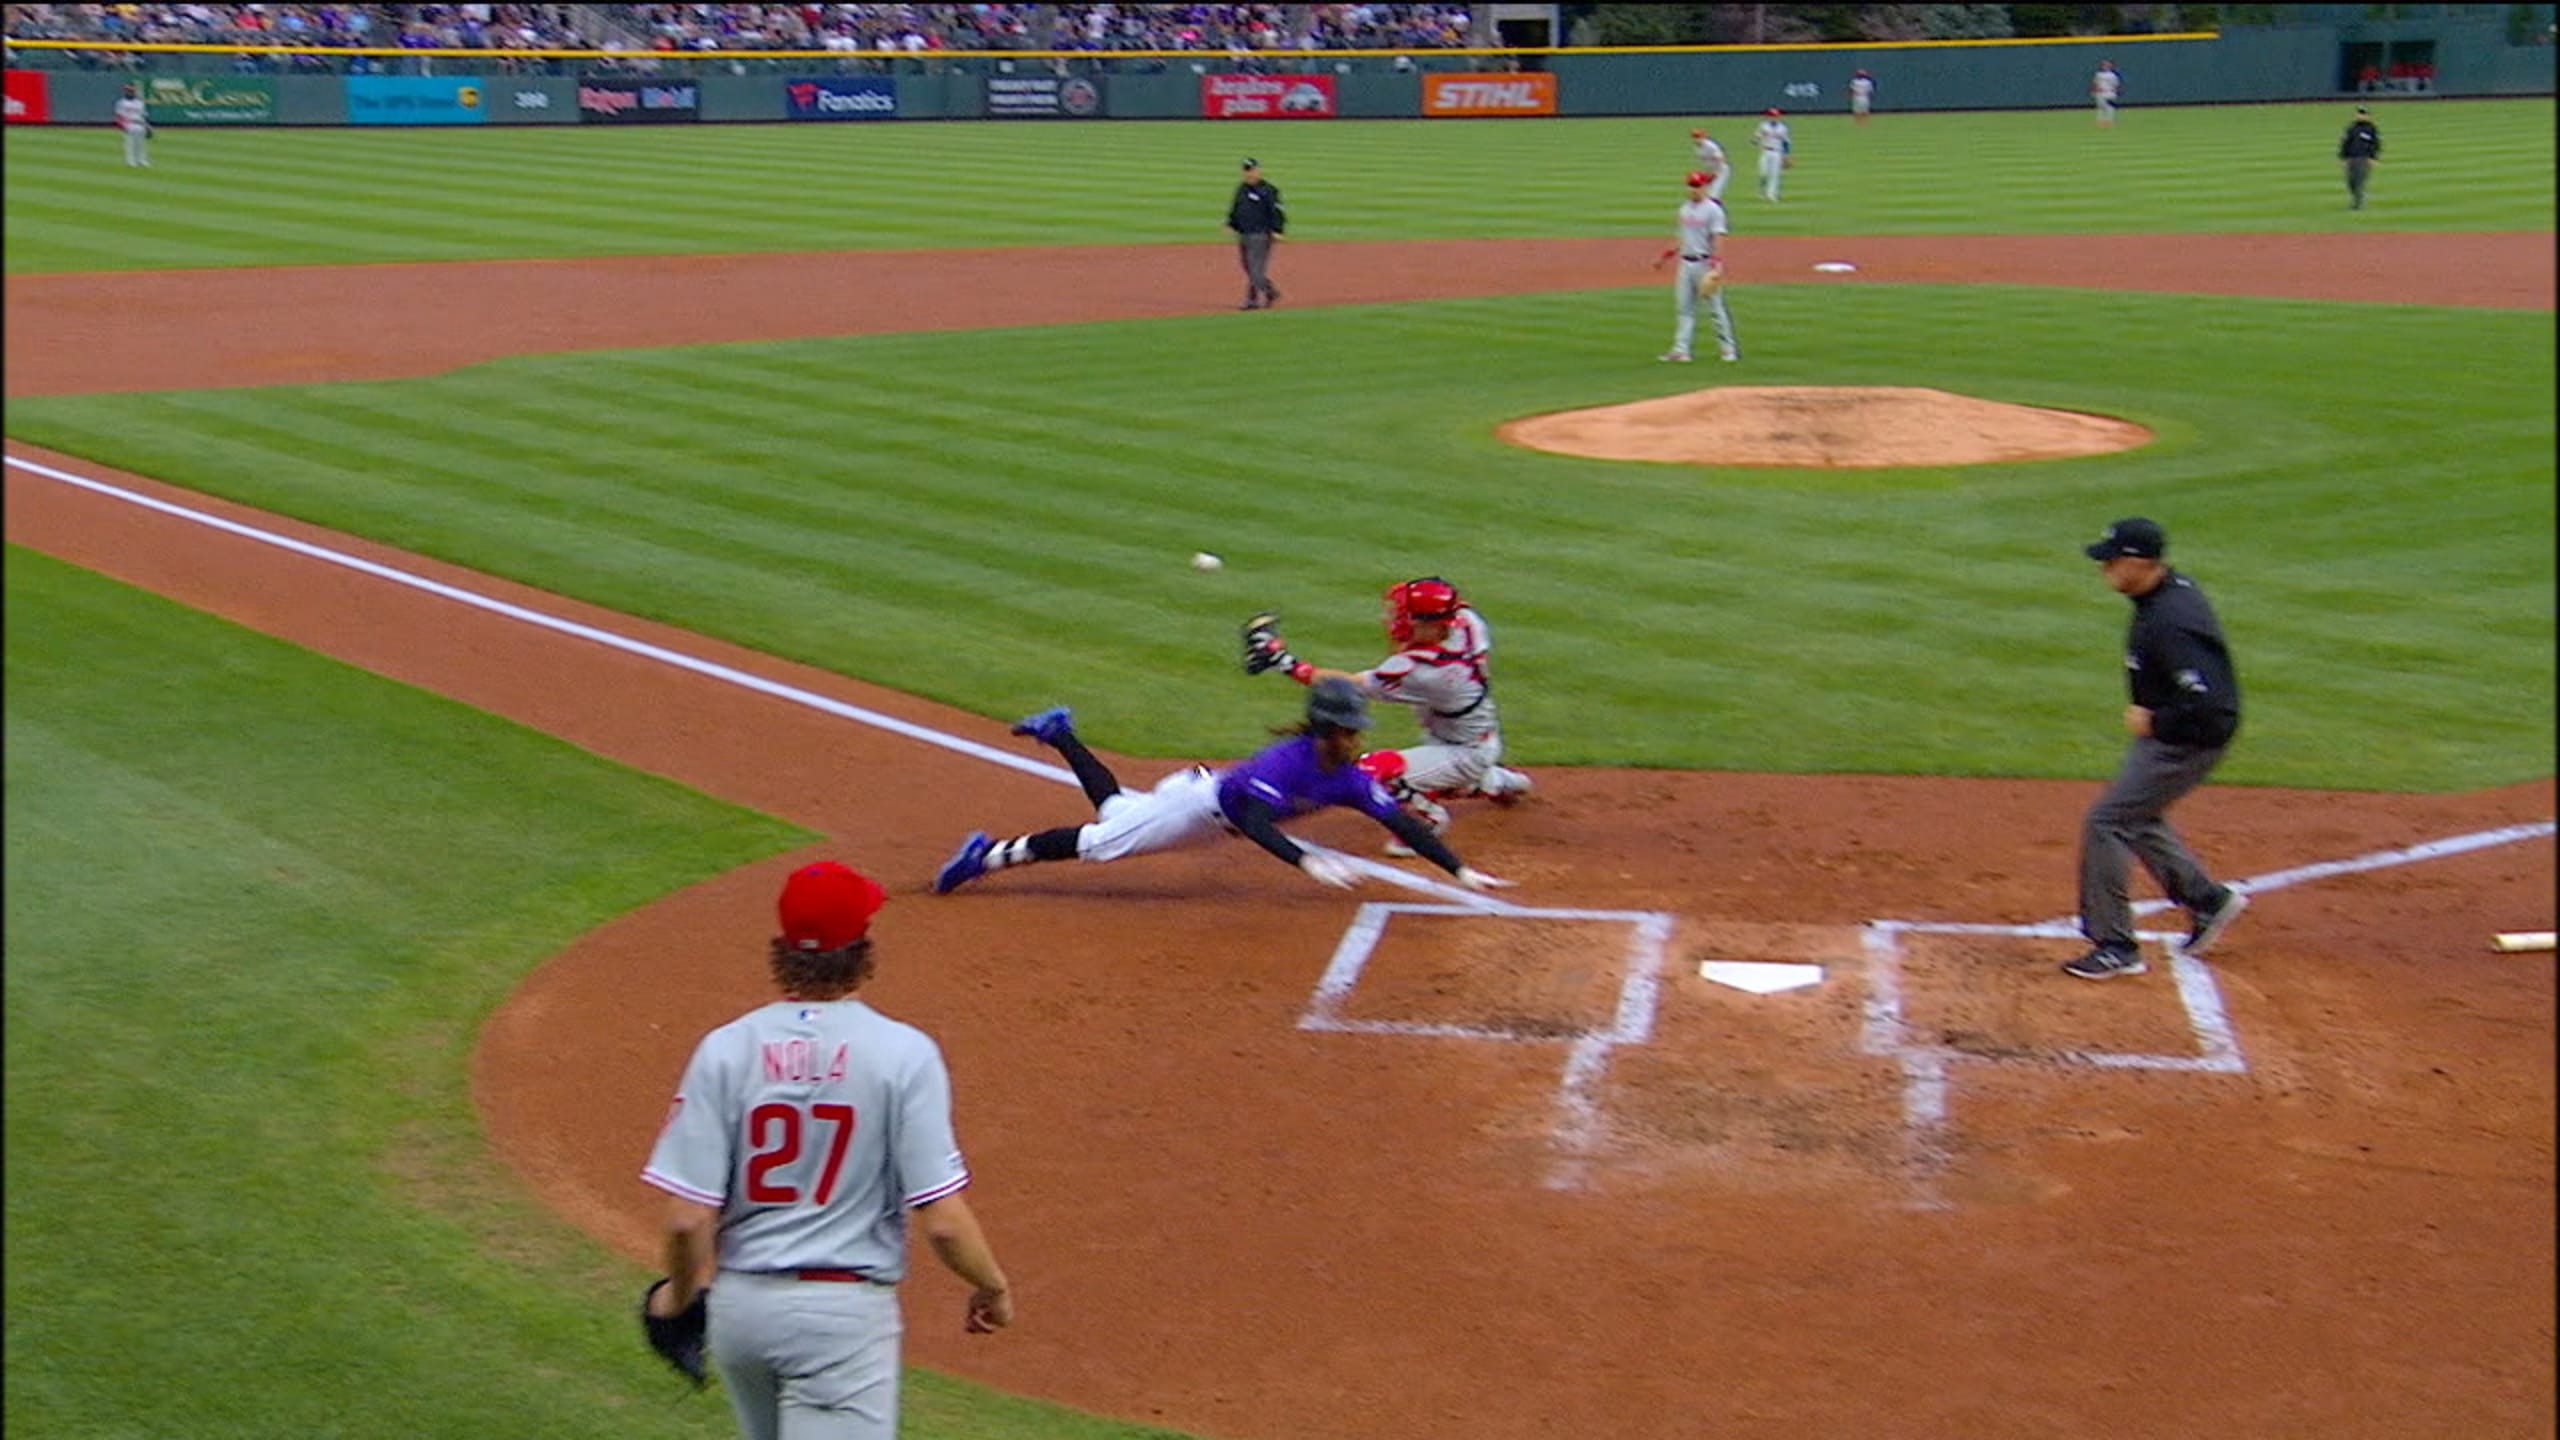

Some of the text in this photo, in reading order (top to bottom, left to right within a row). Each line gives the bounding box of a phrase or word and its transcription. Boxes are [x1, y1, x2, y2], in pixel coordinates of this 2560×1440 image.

[817, 88, 894, 113] Fanatics
[1433, 82, 1540, 108] STIHL
[762, 1038, 849, 1083] NOLA
[746, 1102, 857, 1206] 27
